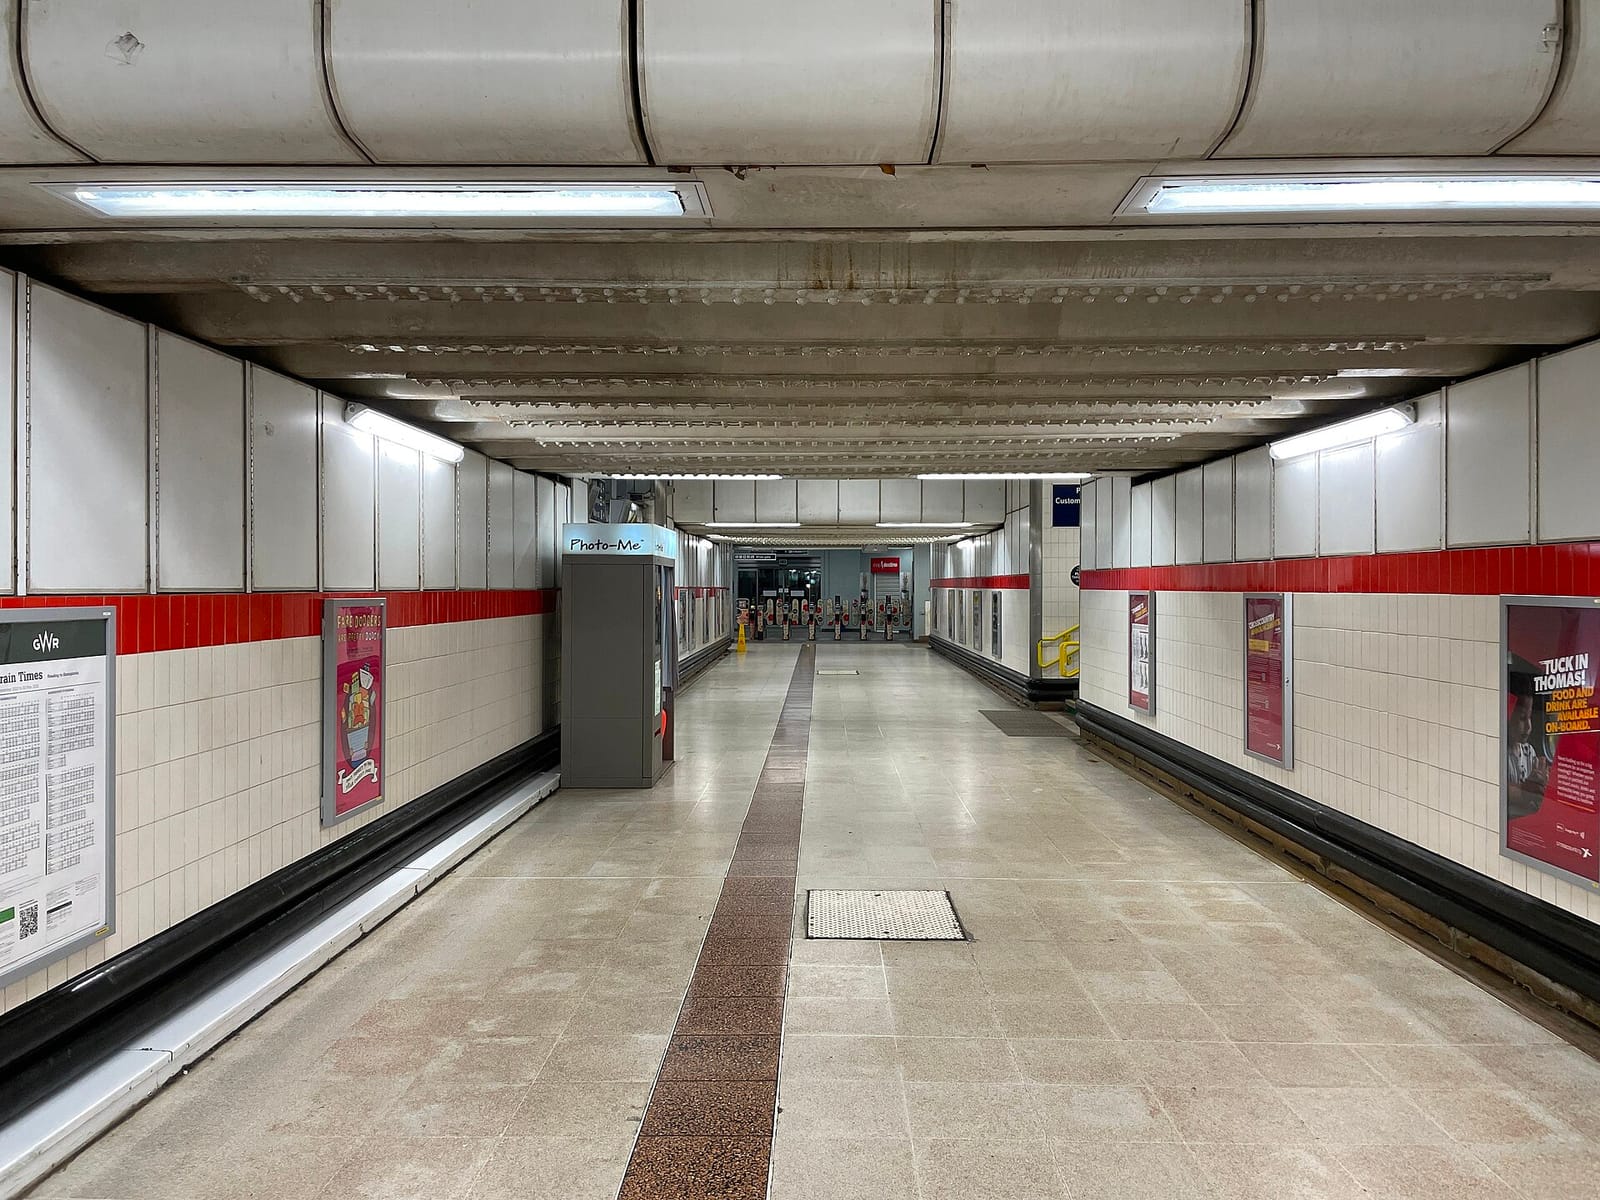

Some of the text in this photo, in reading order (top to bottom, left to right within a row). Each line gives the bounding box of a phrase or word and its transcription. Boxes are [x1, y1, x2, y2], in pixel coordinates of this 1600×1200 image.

[570, 538, 642, 551] Photo-Me
[33, 630, 59, 653] GWR
[1539, 653, 1589, 674] TUCK IN
[18, 671, 43, 682] Times
[1534, 670, 1586, 691] THOMAS!
[1553, 687, 1593, 700] FOOD AND
[1546, 698, 1587, 712] DRINK ARE
[1558, 707, 1598, 720] AVAILABLE
[1546, 721, 1590, 732] ON-BOARD.
